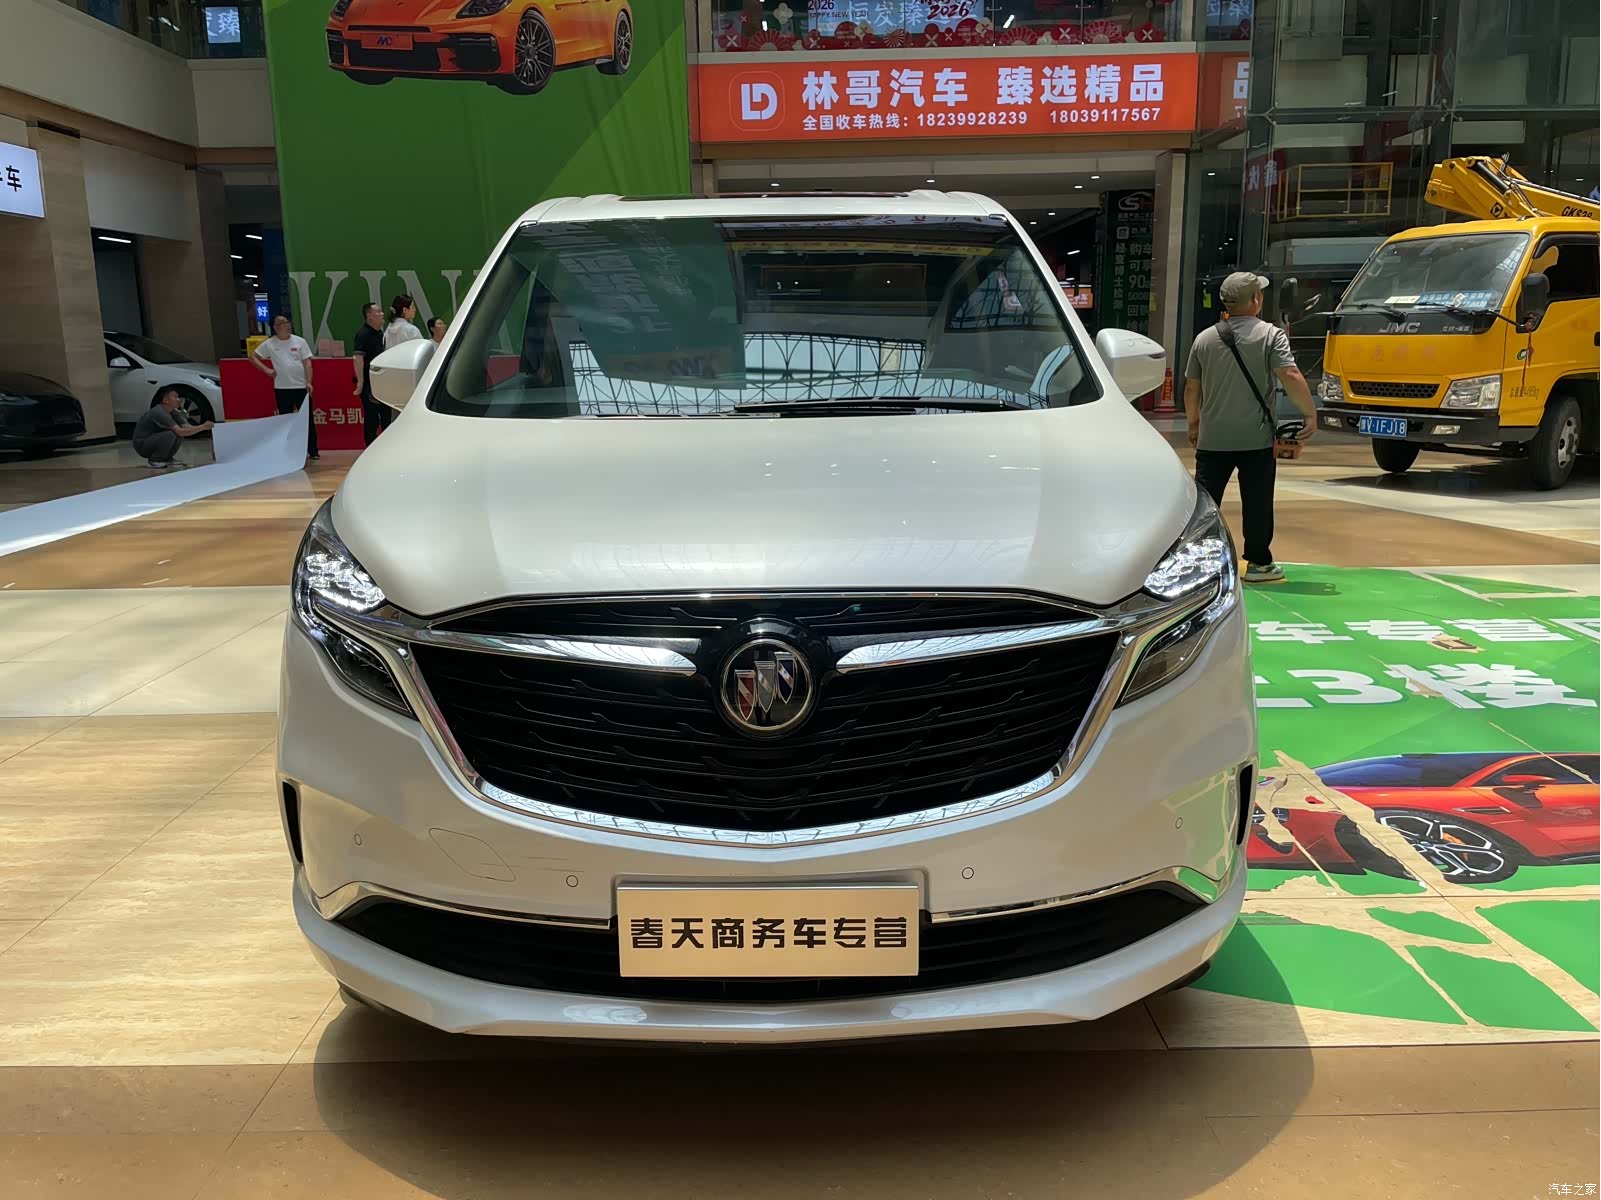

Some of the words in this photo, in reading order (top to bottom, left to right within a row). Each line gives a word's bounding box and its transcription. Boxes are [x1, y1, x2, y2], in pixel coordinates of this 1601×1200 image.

[926, 2, 970, 20] 2026
[802, 67, 969, 110] 林哥汽车
[997, 63, 1164, 105] 臻选精品
[917, 110, 1028, 128] 18239928239
[1050, 107, 1161, 124] 18039117567
[289, 270, 487, 356] KIN
[1379, 322, 1420, 333] JMC
[313, 408, 365, 424] 金马凯
[630, 916, 908, 950] 春天商务车专营
